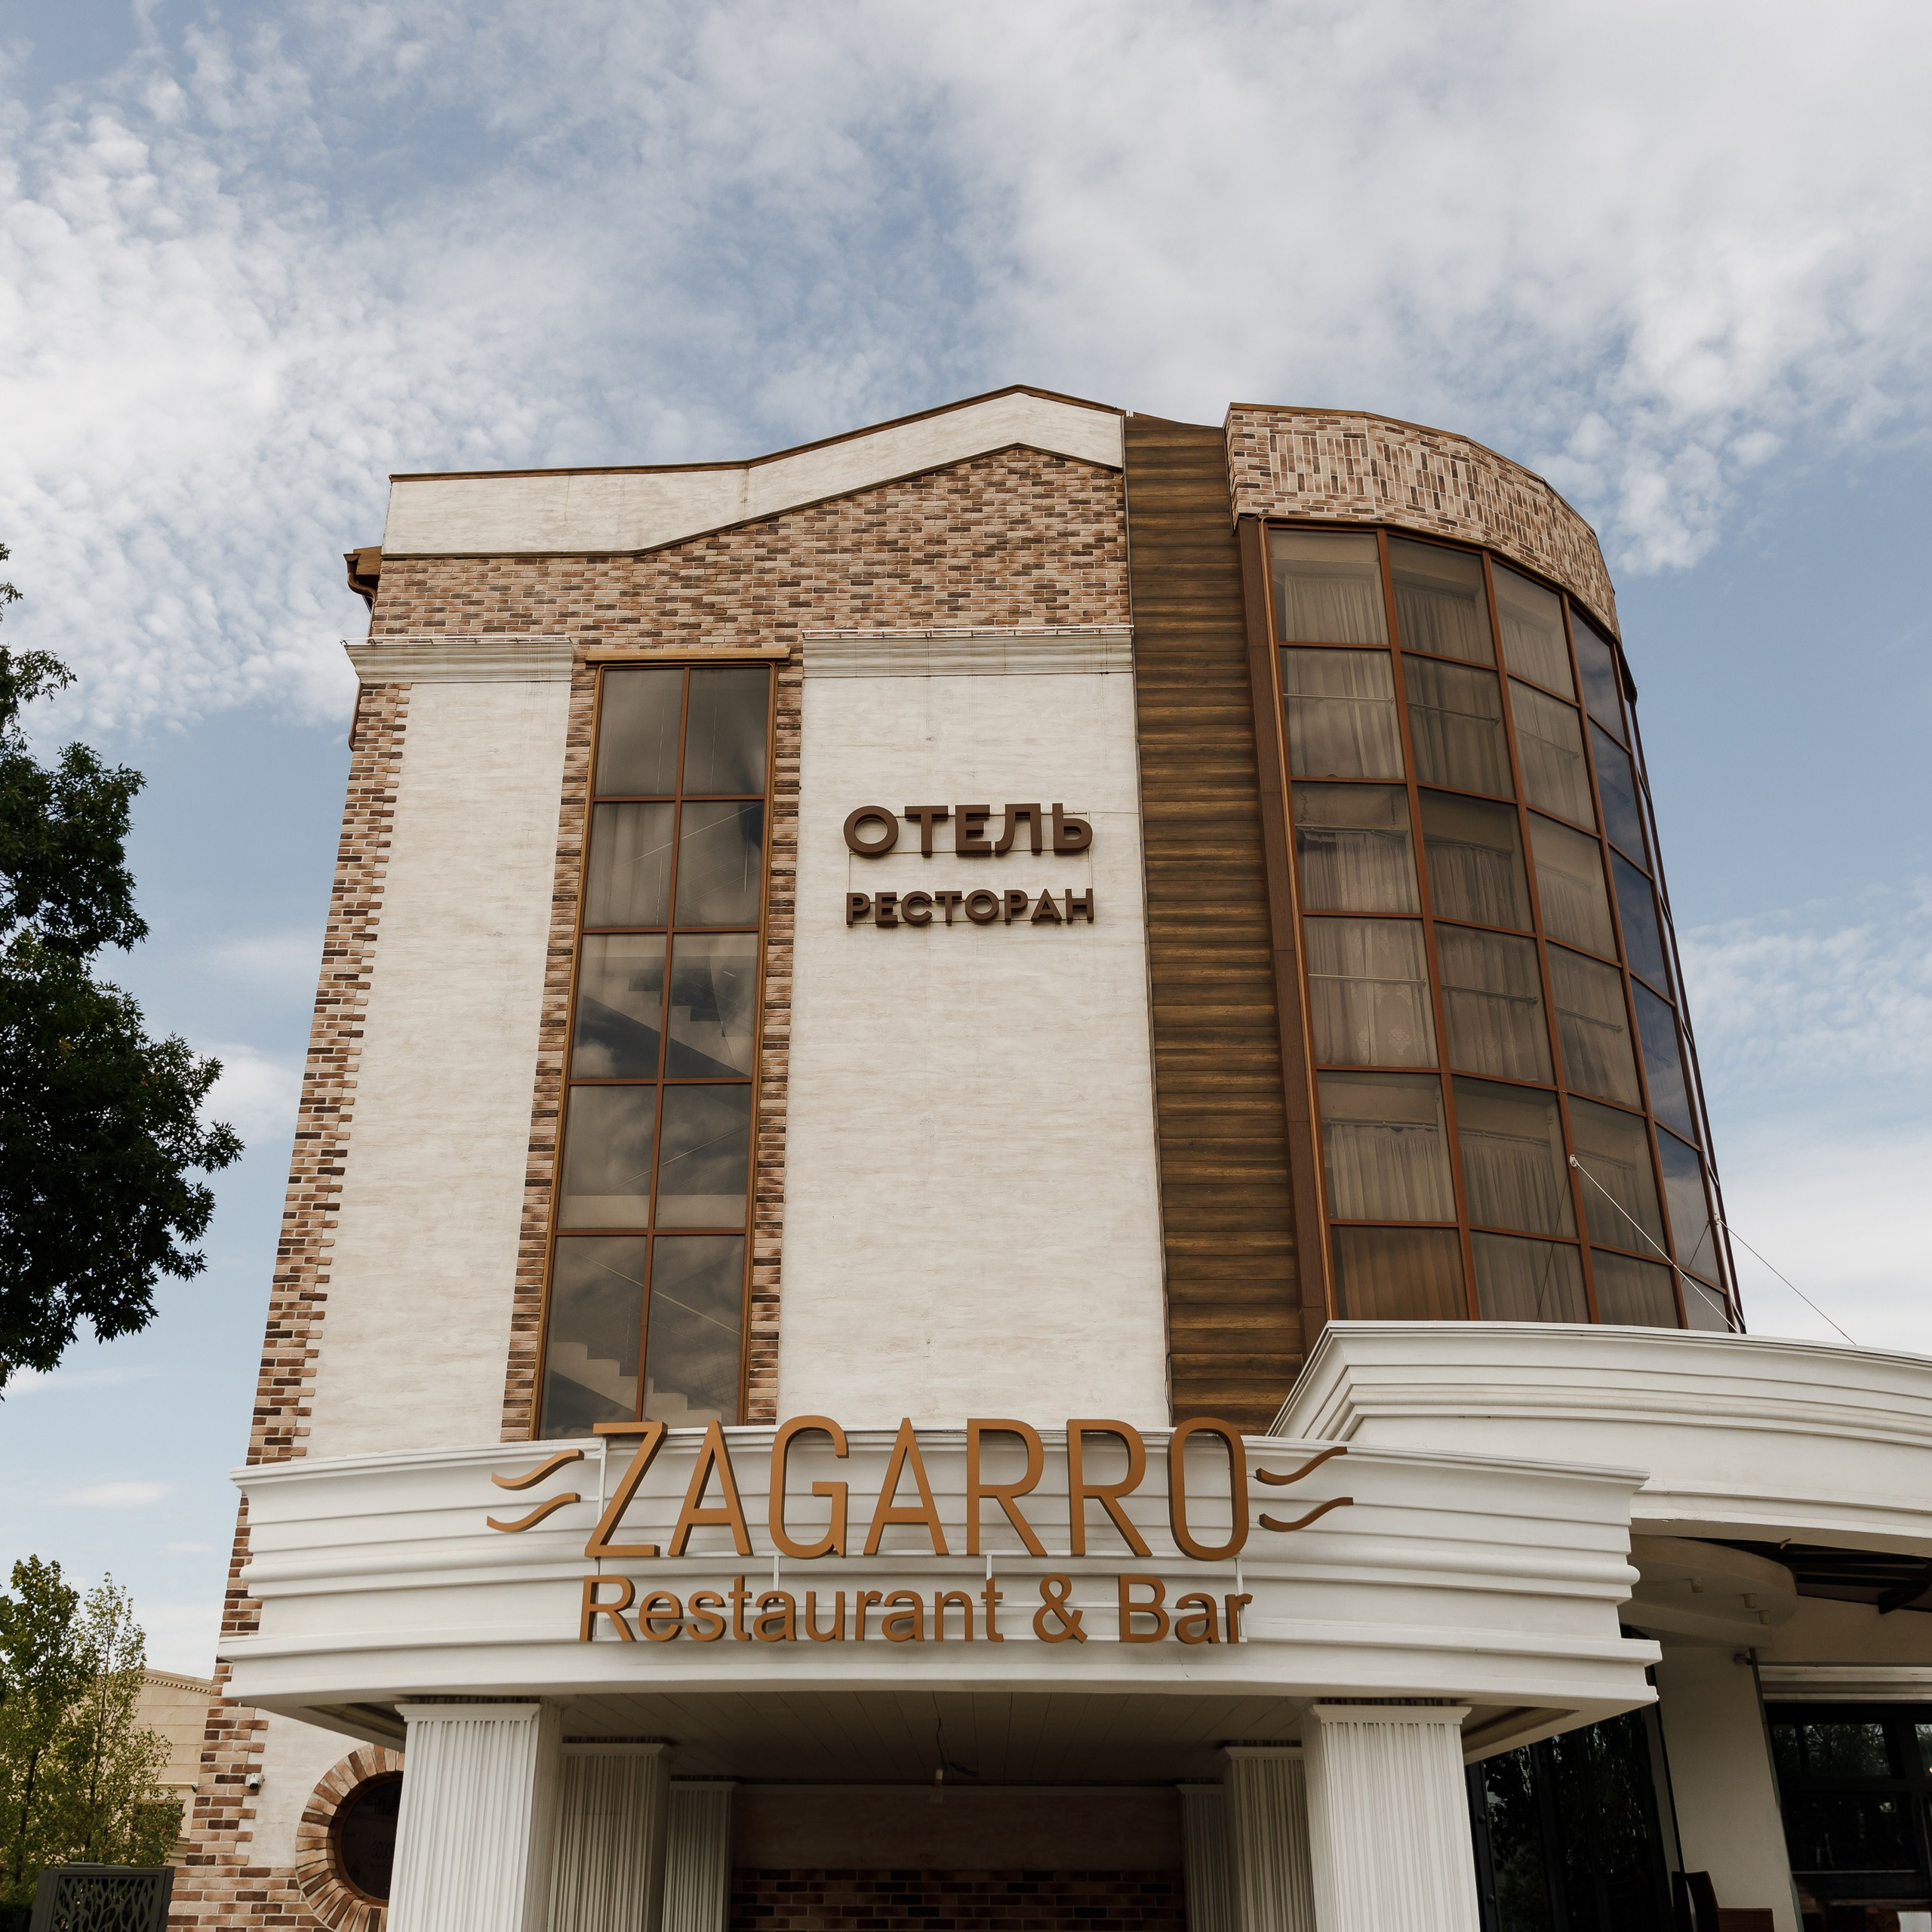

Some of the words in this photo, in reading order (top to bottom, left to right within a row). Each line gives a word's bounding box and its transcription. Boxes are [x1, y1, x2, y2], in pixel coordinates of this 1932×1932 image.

[844, 802, 1093, 857] ОТЕЛЬ
[846, 888, 1094, 925] РЕСТОРАН
[584, 1416, 1249, 1561] ZAGARRO
[579, 1575, 1004, 1641] Restaurant
[1032, 1573, 1088, 1643] &
[1118, 1574, 1253, 1644] Bar
